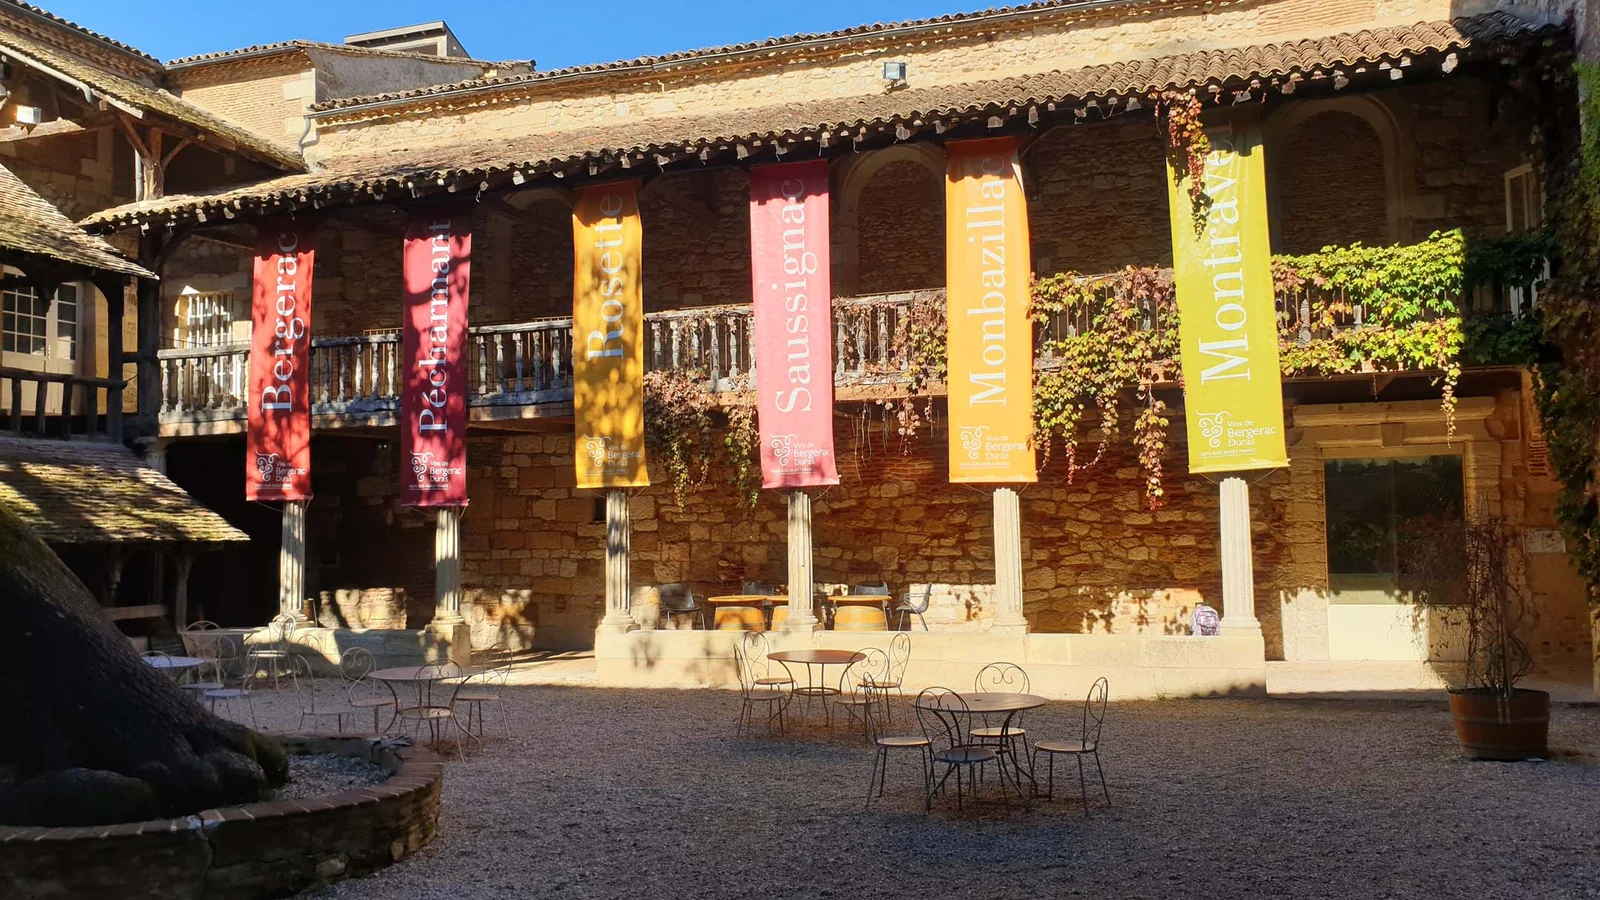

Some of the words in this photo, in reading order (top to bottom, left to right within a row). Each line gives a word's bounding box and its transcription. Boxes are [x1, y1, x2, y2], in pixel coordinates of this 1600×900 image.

[1198, 119, 1251, 386] Montravel
[587, 195, 624, 362] Rosette
[966, 156, 1007, 408] Monbazillac
[772, 178, 818, 413] Saussignac
[261, 232, 305, 413] Bergerac
[418, 219, 451, 434] Pécharmant
[1228, 426, 1276, 439] Bergerac
[1228, 438, 1256, 447] Duras
[608, 450, 642, 460] Bergerac
[794, 449, 830, 459] Bergerac
[985, 452, 1009, 460] Duras
[794, 458, 815, 466] Duras
[276, 466, 306, 477] Bergerac
[430, 467, 462, 477] Bergerac
